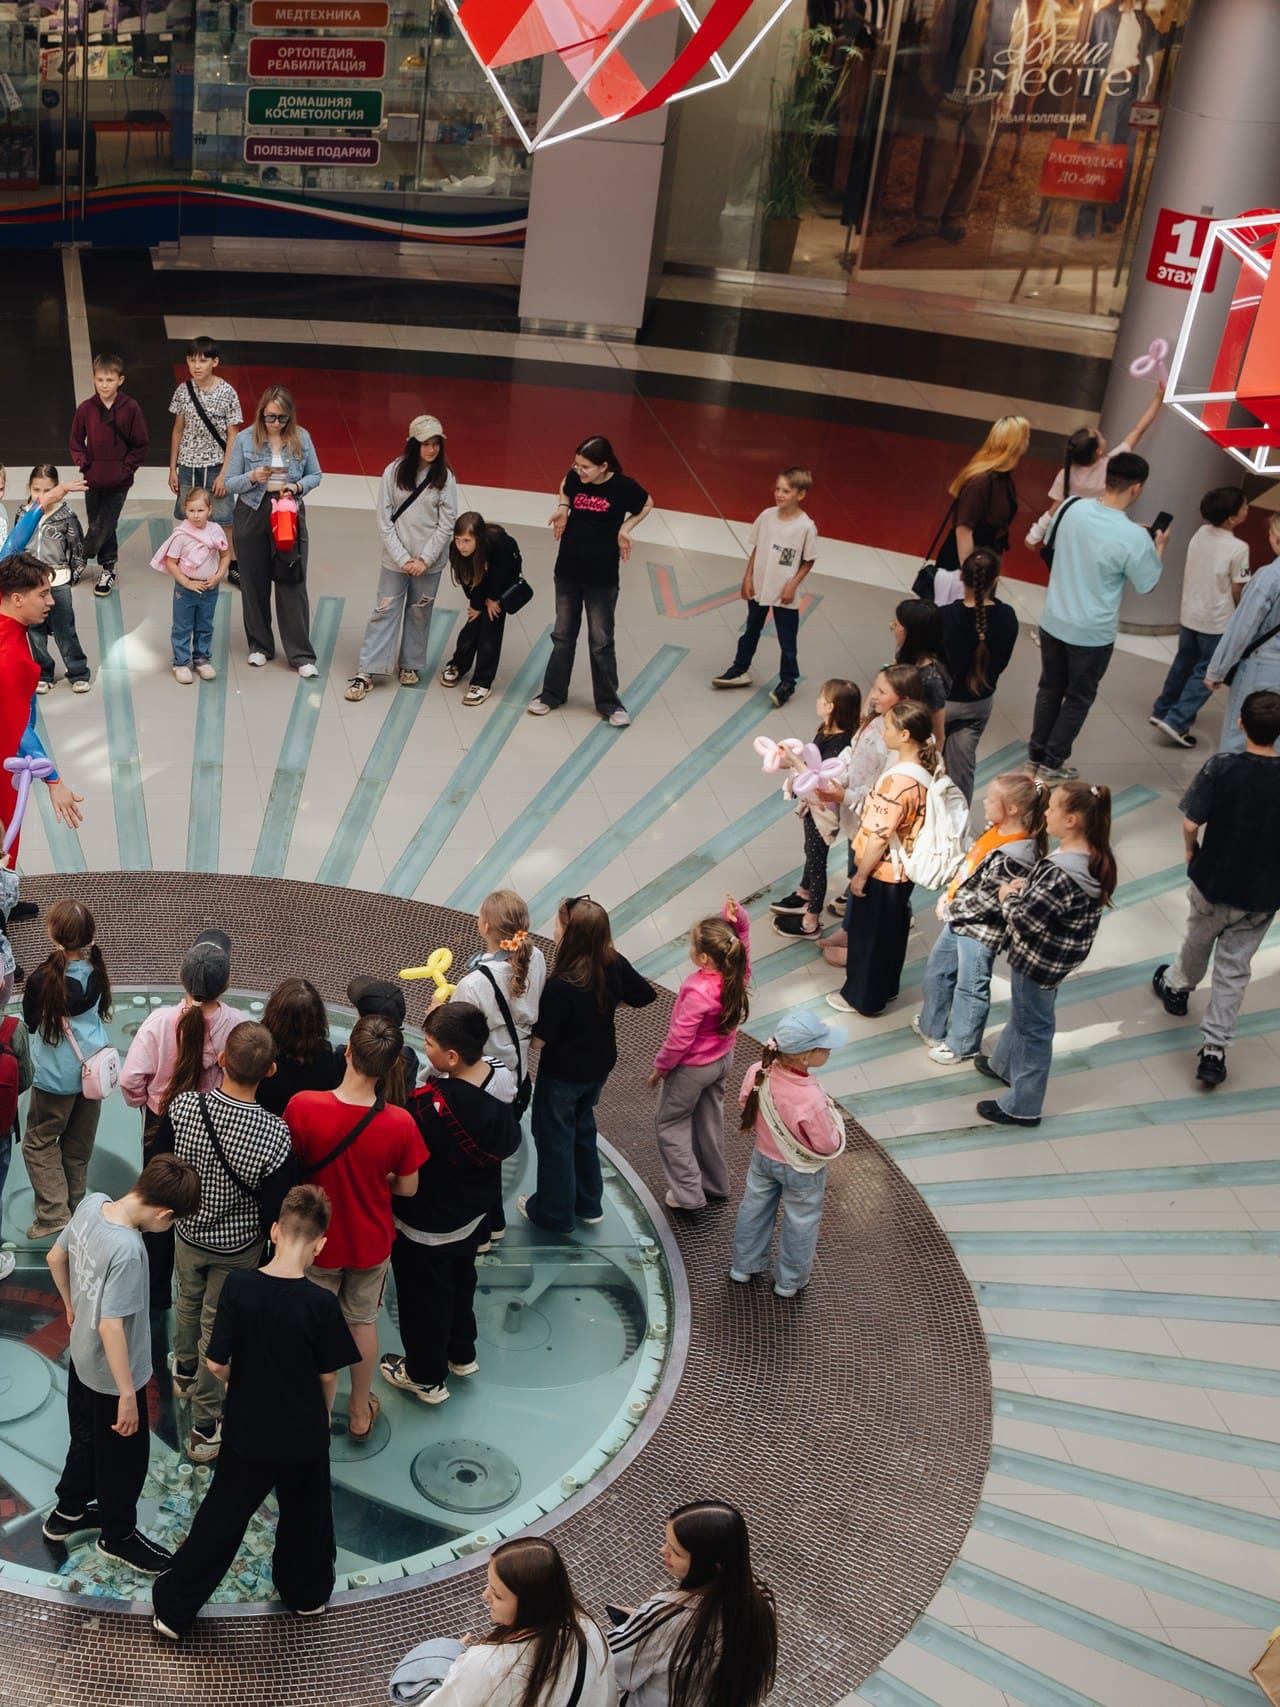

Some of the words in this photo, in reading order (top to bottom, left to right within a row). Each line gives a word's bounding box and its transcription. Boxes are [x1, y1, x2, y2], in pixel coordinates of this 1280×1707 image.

[275, 9, 361, 22] МЕДТЕХНИКА
[993, 19, 1111, 65] Весна
[278, 47, 357, 59] ОРТОПЕДИЯ,
[267, 59, 367, 73] РЕАБИЛИТАЦИЯ
[277, 96, 352, 108] ДОМАШНЯЯ
[265, 108, 365, 120] КОСМЕТОЛОГИЯ
[991, 114, 1025, 124] НОВАЯ
[1027, 112, 1089, 124] КОЛЛЕКЦИЯ
[254, 145, 315, 157] ПОЛЕЗНЫЕ
[316, 146, 371, 159] ПОДАРКИ
[1048, 152, 1124, 169] РАСПРОДАЖА
[1057, 170, 1078, 185] ДО
[1164, 219, 1201, 270] 1
